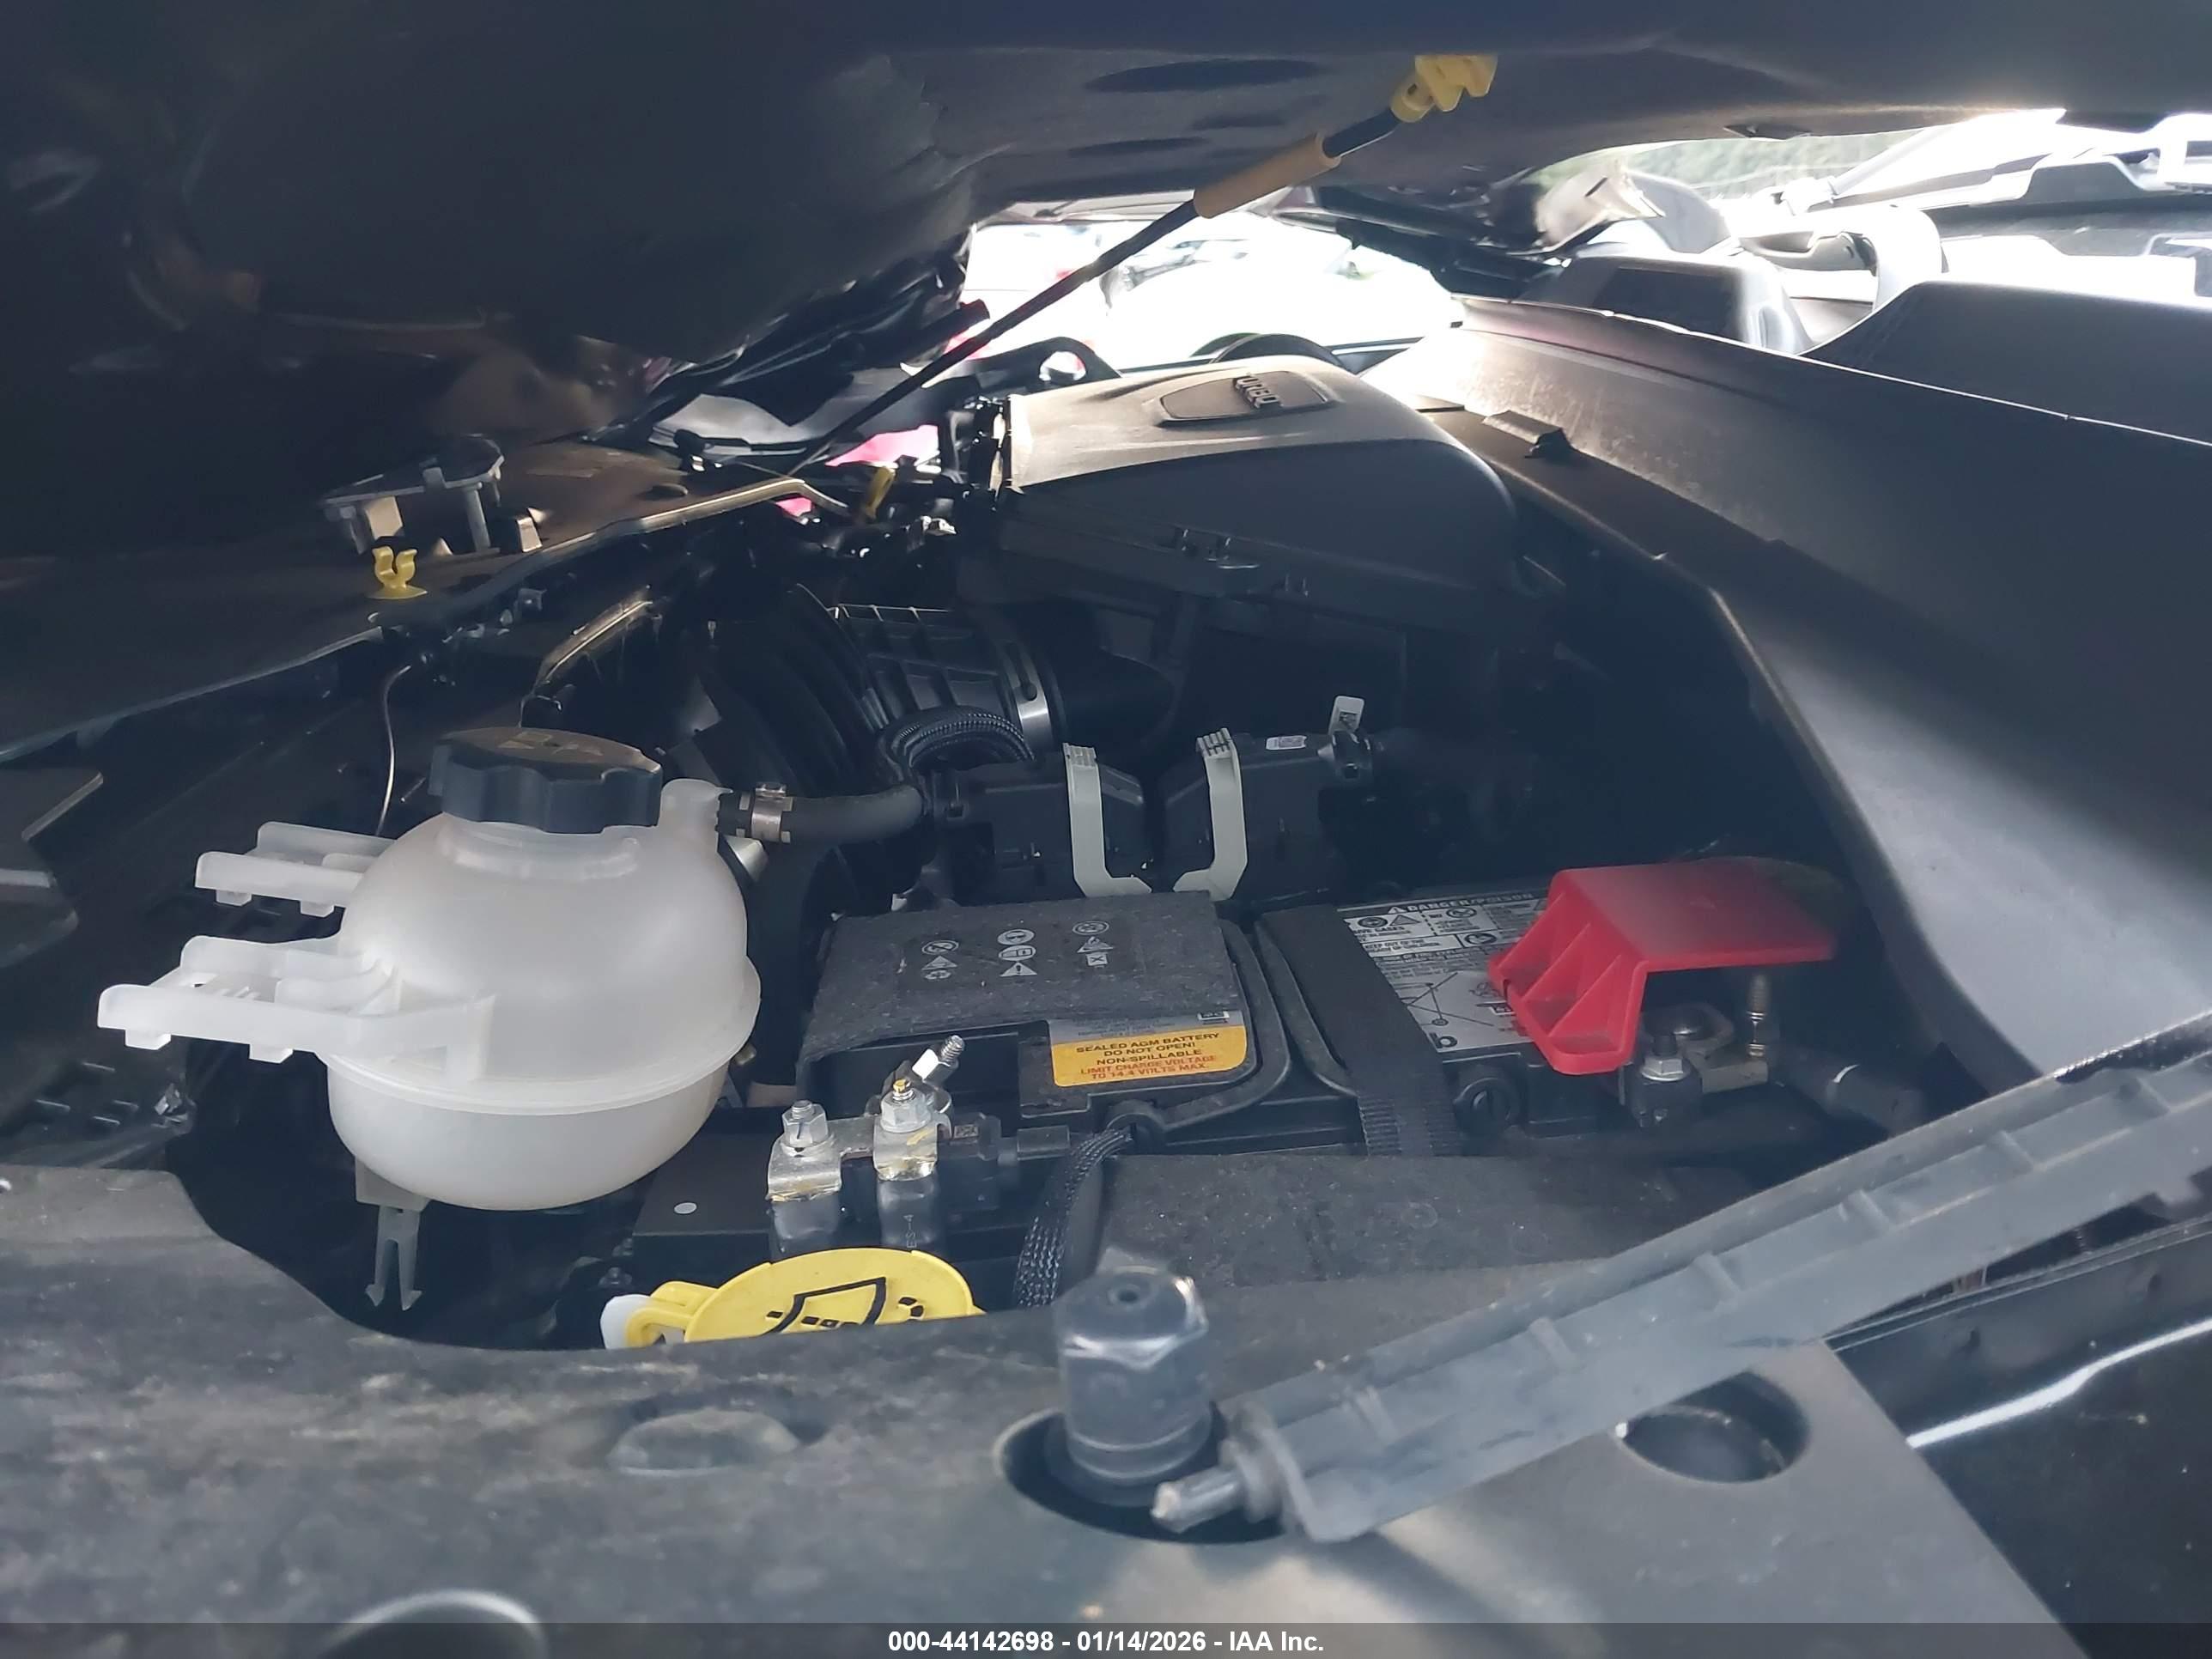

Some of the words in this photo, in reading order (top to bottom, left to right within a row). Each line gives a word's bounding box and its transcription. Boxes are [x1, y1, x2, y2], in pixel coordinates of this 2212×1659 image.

[1076, 1042, 1127, 1053] SEALED
[1130, 1039, 1159, 1048] AGM
[1163, 1033, 1219, 1044] BATTERY
[1156, 1042, 1196, 1051] OPEN!
[1080, 1066, 1114, 1074] LIMIT
[1115, 1061, 1164, 1071] CHARGE
[1165, 1055, 1216, 1066] VOLTAGE
[1097, 1049, 1202, 1065] NON-SPILLABLE
[1138, 1066, 1176, 1075] VOLTS
